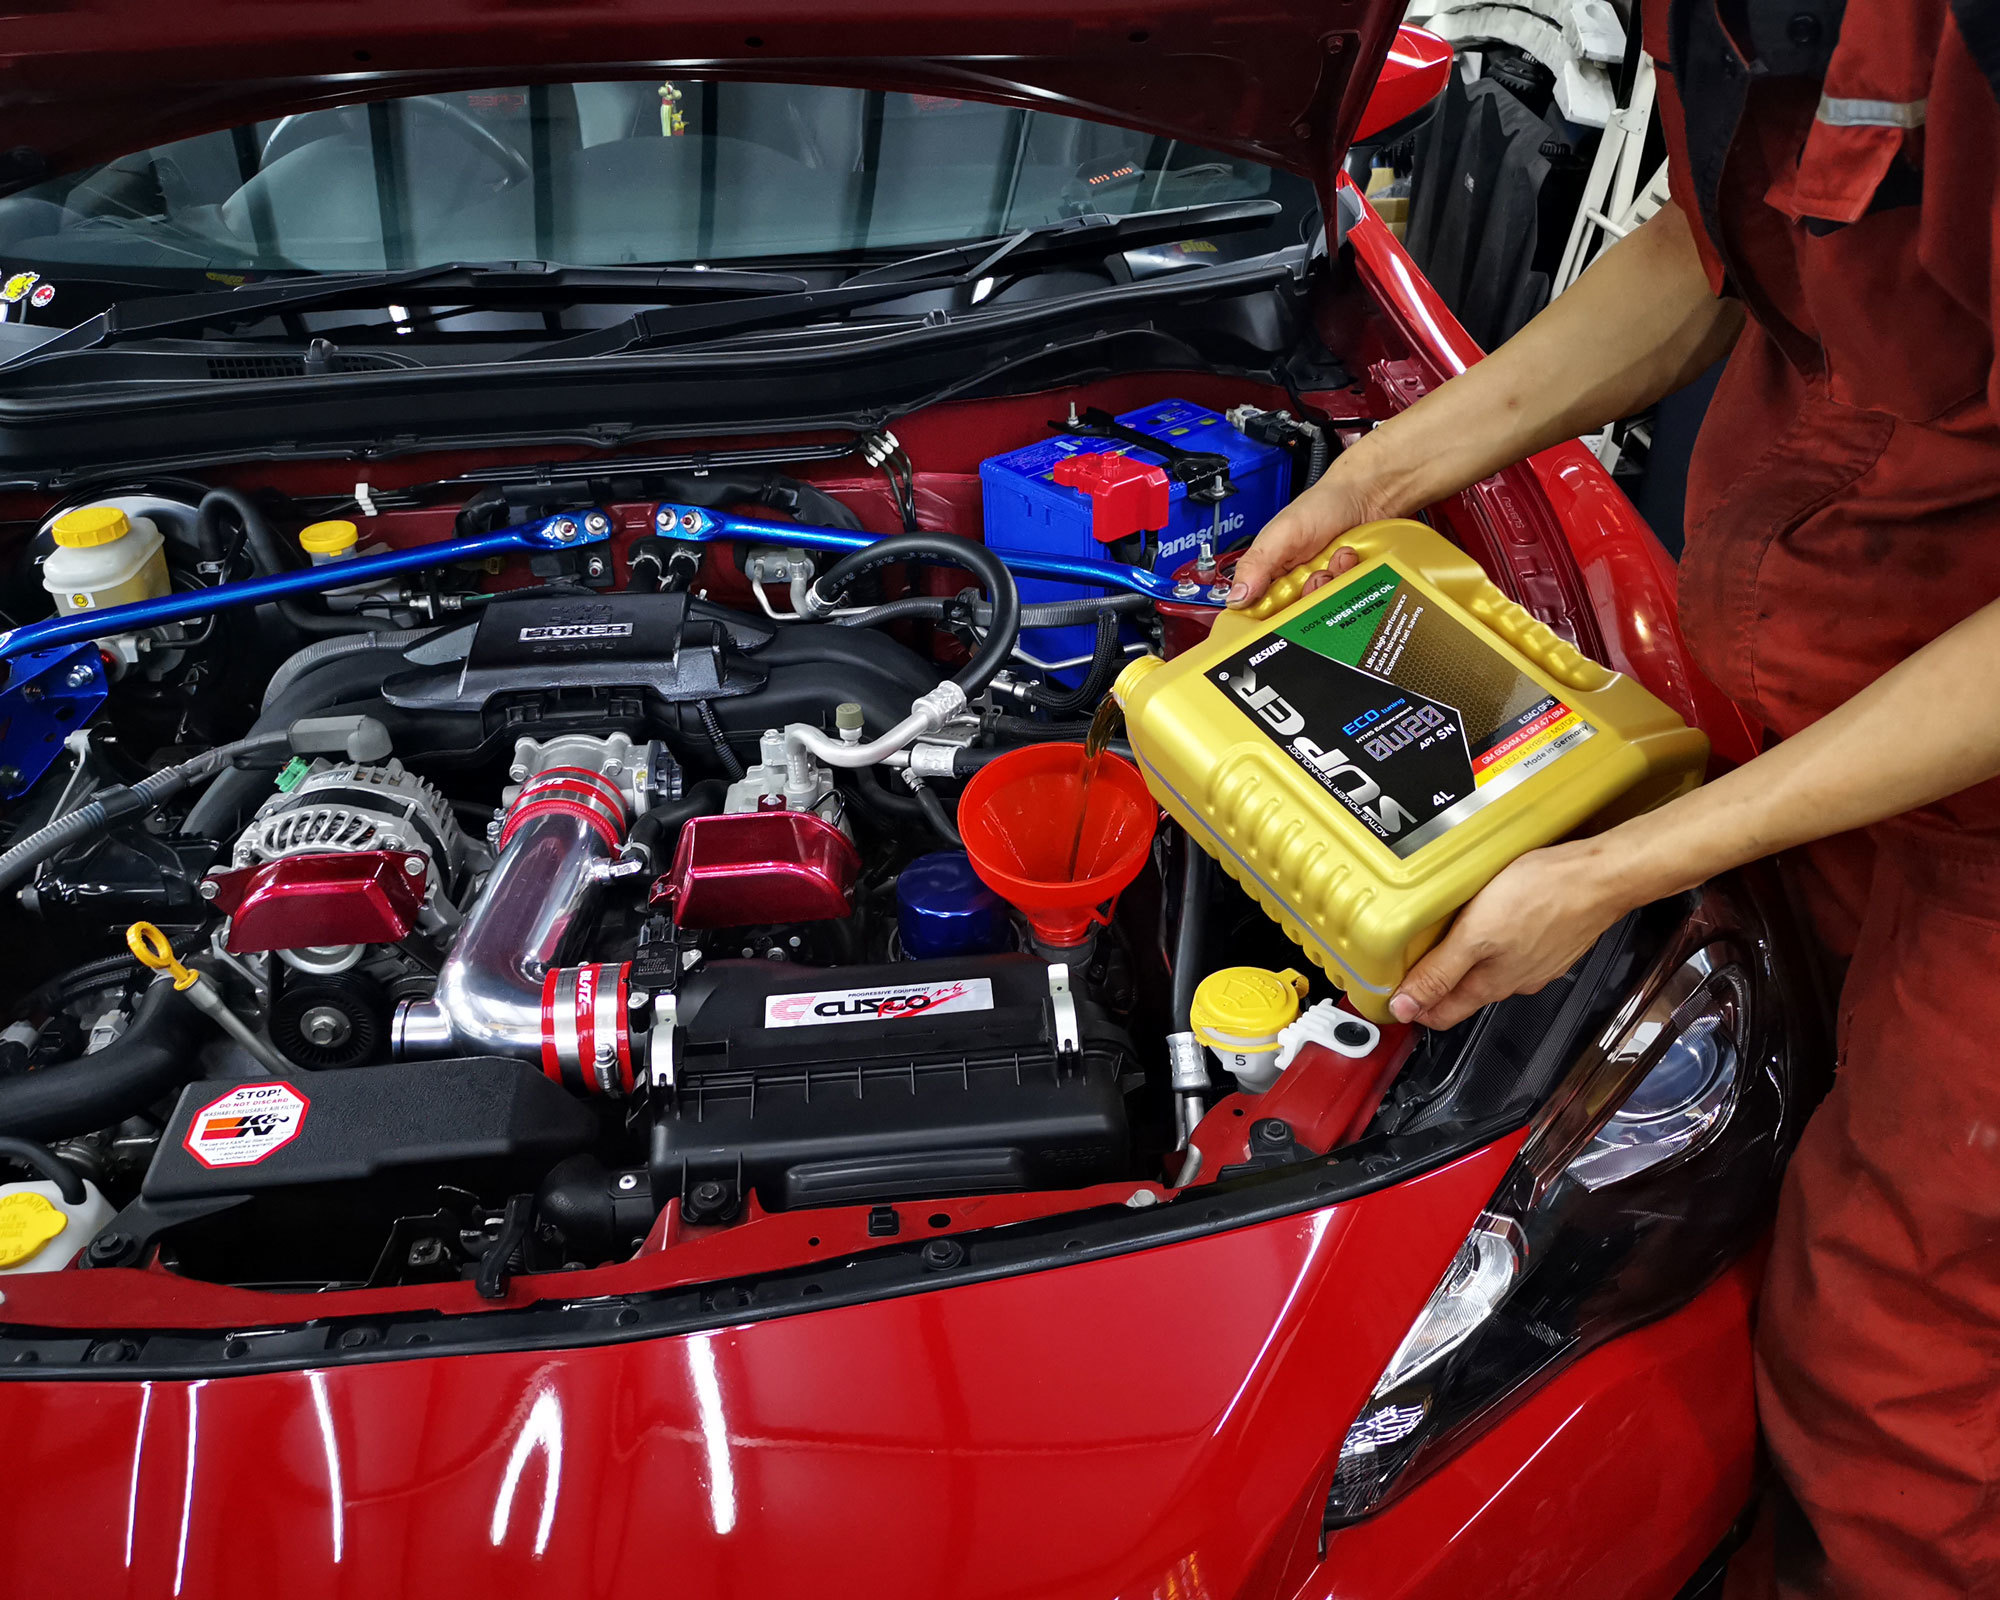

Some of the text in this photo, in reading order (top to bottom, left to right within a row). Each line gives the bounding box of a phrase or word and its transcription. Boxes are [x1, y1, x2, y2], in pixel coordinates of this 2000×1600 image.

[1300, 579, 1388, 634] 100% FULLY SYNTHETIC
[1326, 584, 1395, 627] SUPER MOTOR OIL
[525, 625, 627, 638] BOXER
[1365, 594, 1407, 668] Ultra high performance
[1374, 613, 1408, 672] Extra horsepower
[1383, 606, 1424, 676] Economy fuel saving
[1248, 638, 1288, 667] RESURS
[1342, 697, 1406, 736] ECO tuning
[1374, 705, 1414, 733] Enhancement
[1518, 709, 1540, 725] ILSAC
[1228, 663, 1418, 833] SUPER
[1420, 723, 1457, 750] API SN
[1523, 724, 1589, 768] Made in Germany
[1481, 752, 1496, 765] GM
[1285, 743, 1389, 837] ACTIVE POWER TECHNOLOGY
[1432, 791, 1456, 806] 4L
[578, 970, 593, 1009] BLITZ
[848, 987, 930, 998] PROGRESSIVE EQUIPMENT
[814, 995, 932, 1017] CUSCO
[1235, 1054, 1247, 1066] 5
[235, 1088, 282, 1100] STOP!
[252, 1098, 289, 1106] DISCARD
